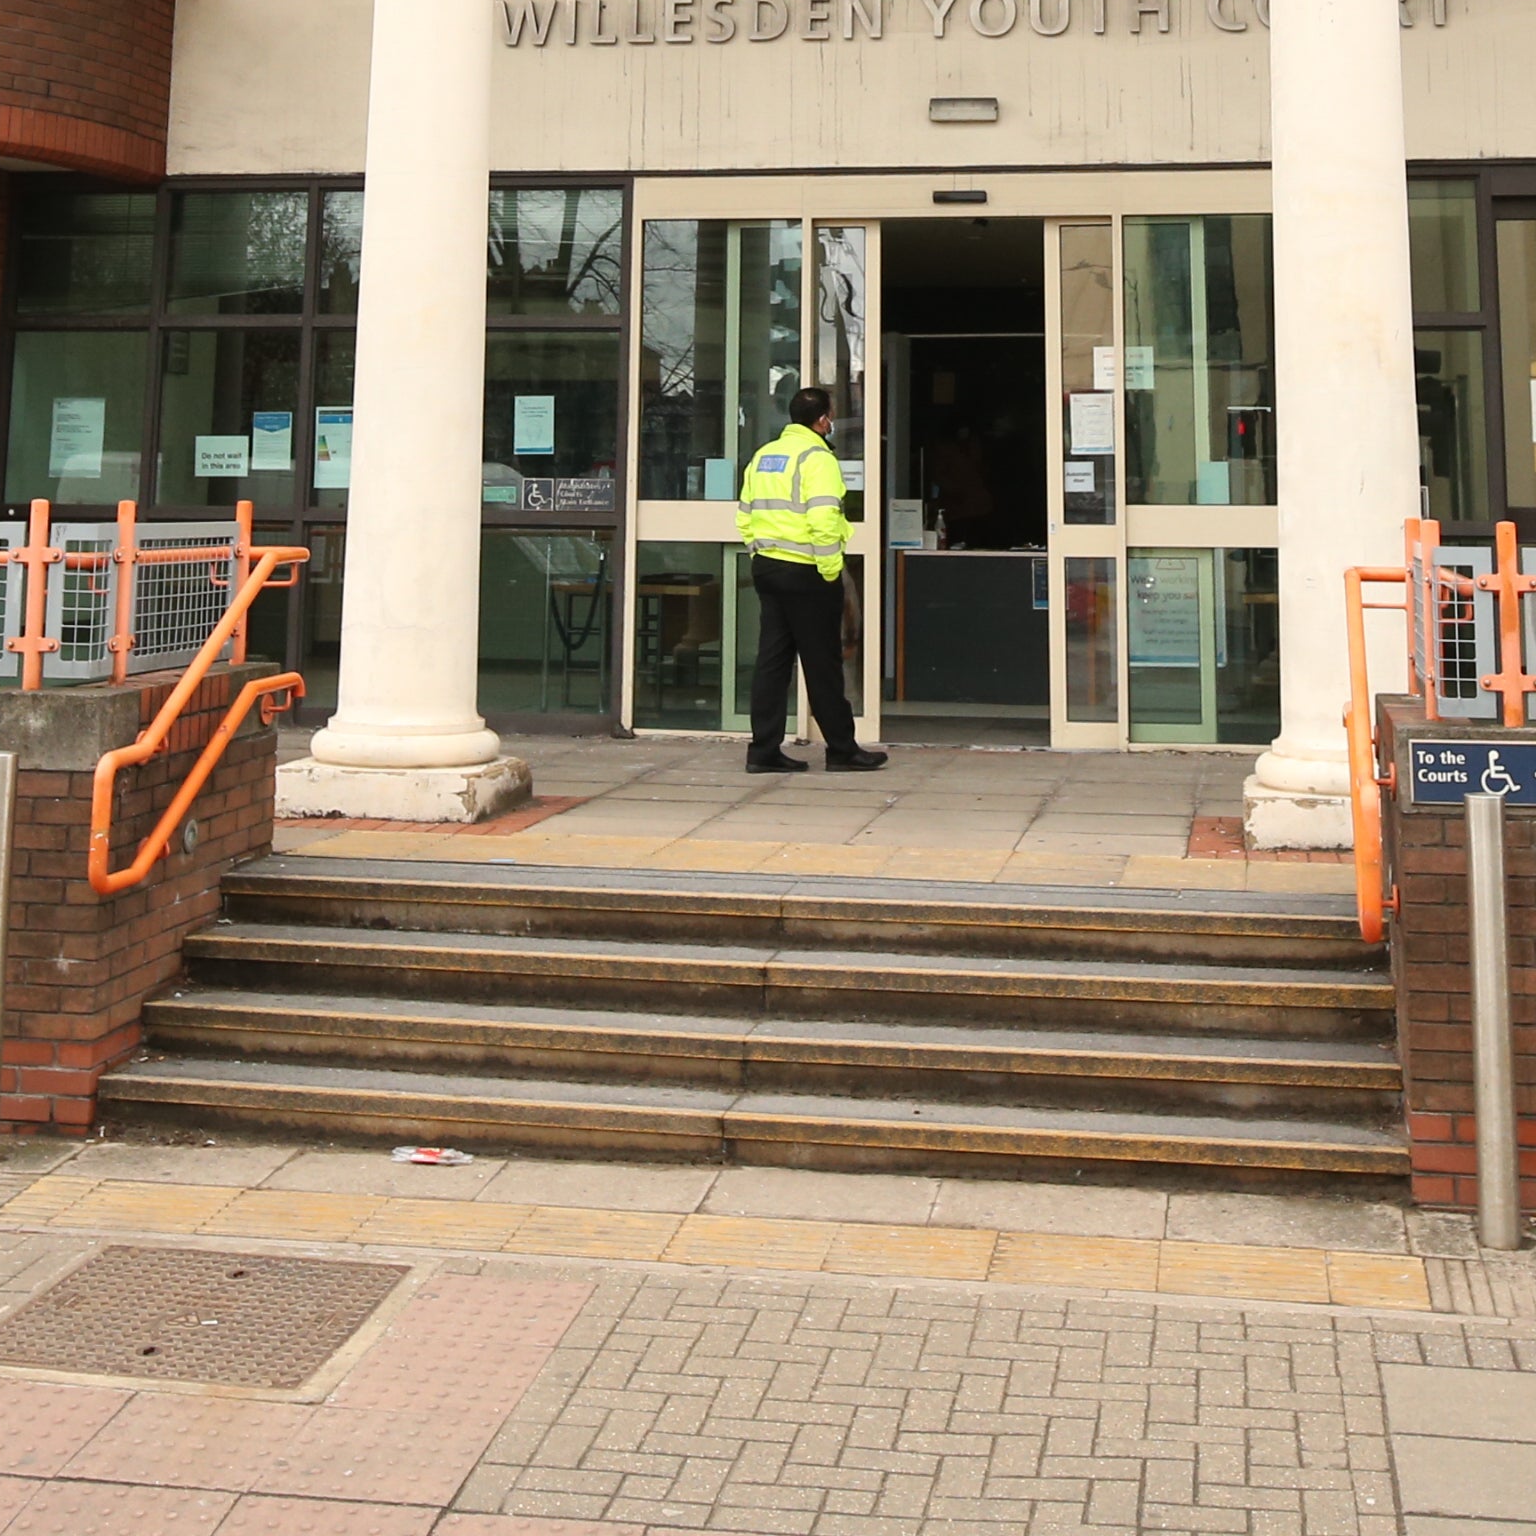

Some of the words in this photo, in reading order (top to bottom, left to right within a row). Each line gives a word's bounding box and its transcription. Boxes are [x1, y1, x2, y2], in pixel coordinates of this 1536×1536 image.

[1416, 750, 1435, 764] To
[1439, 750, 1466, 764] the
[1417, 768, 1468, 783] Courts
